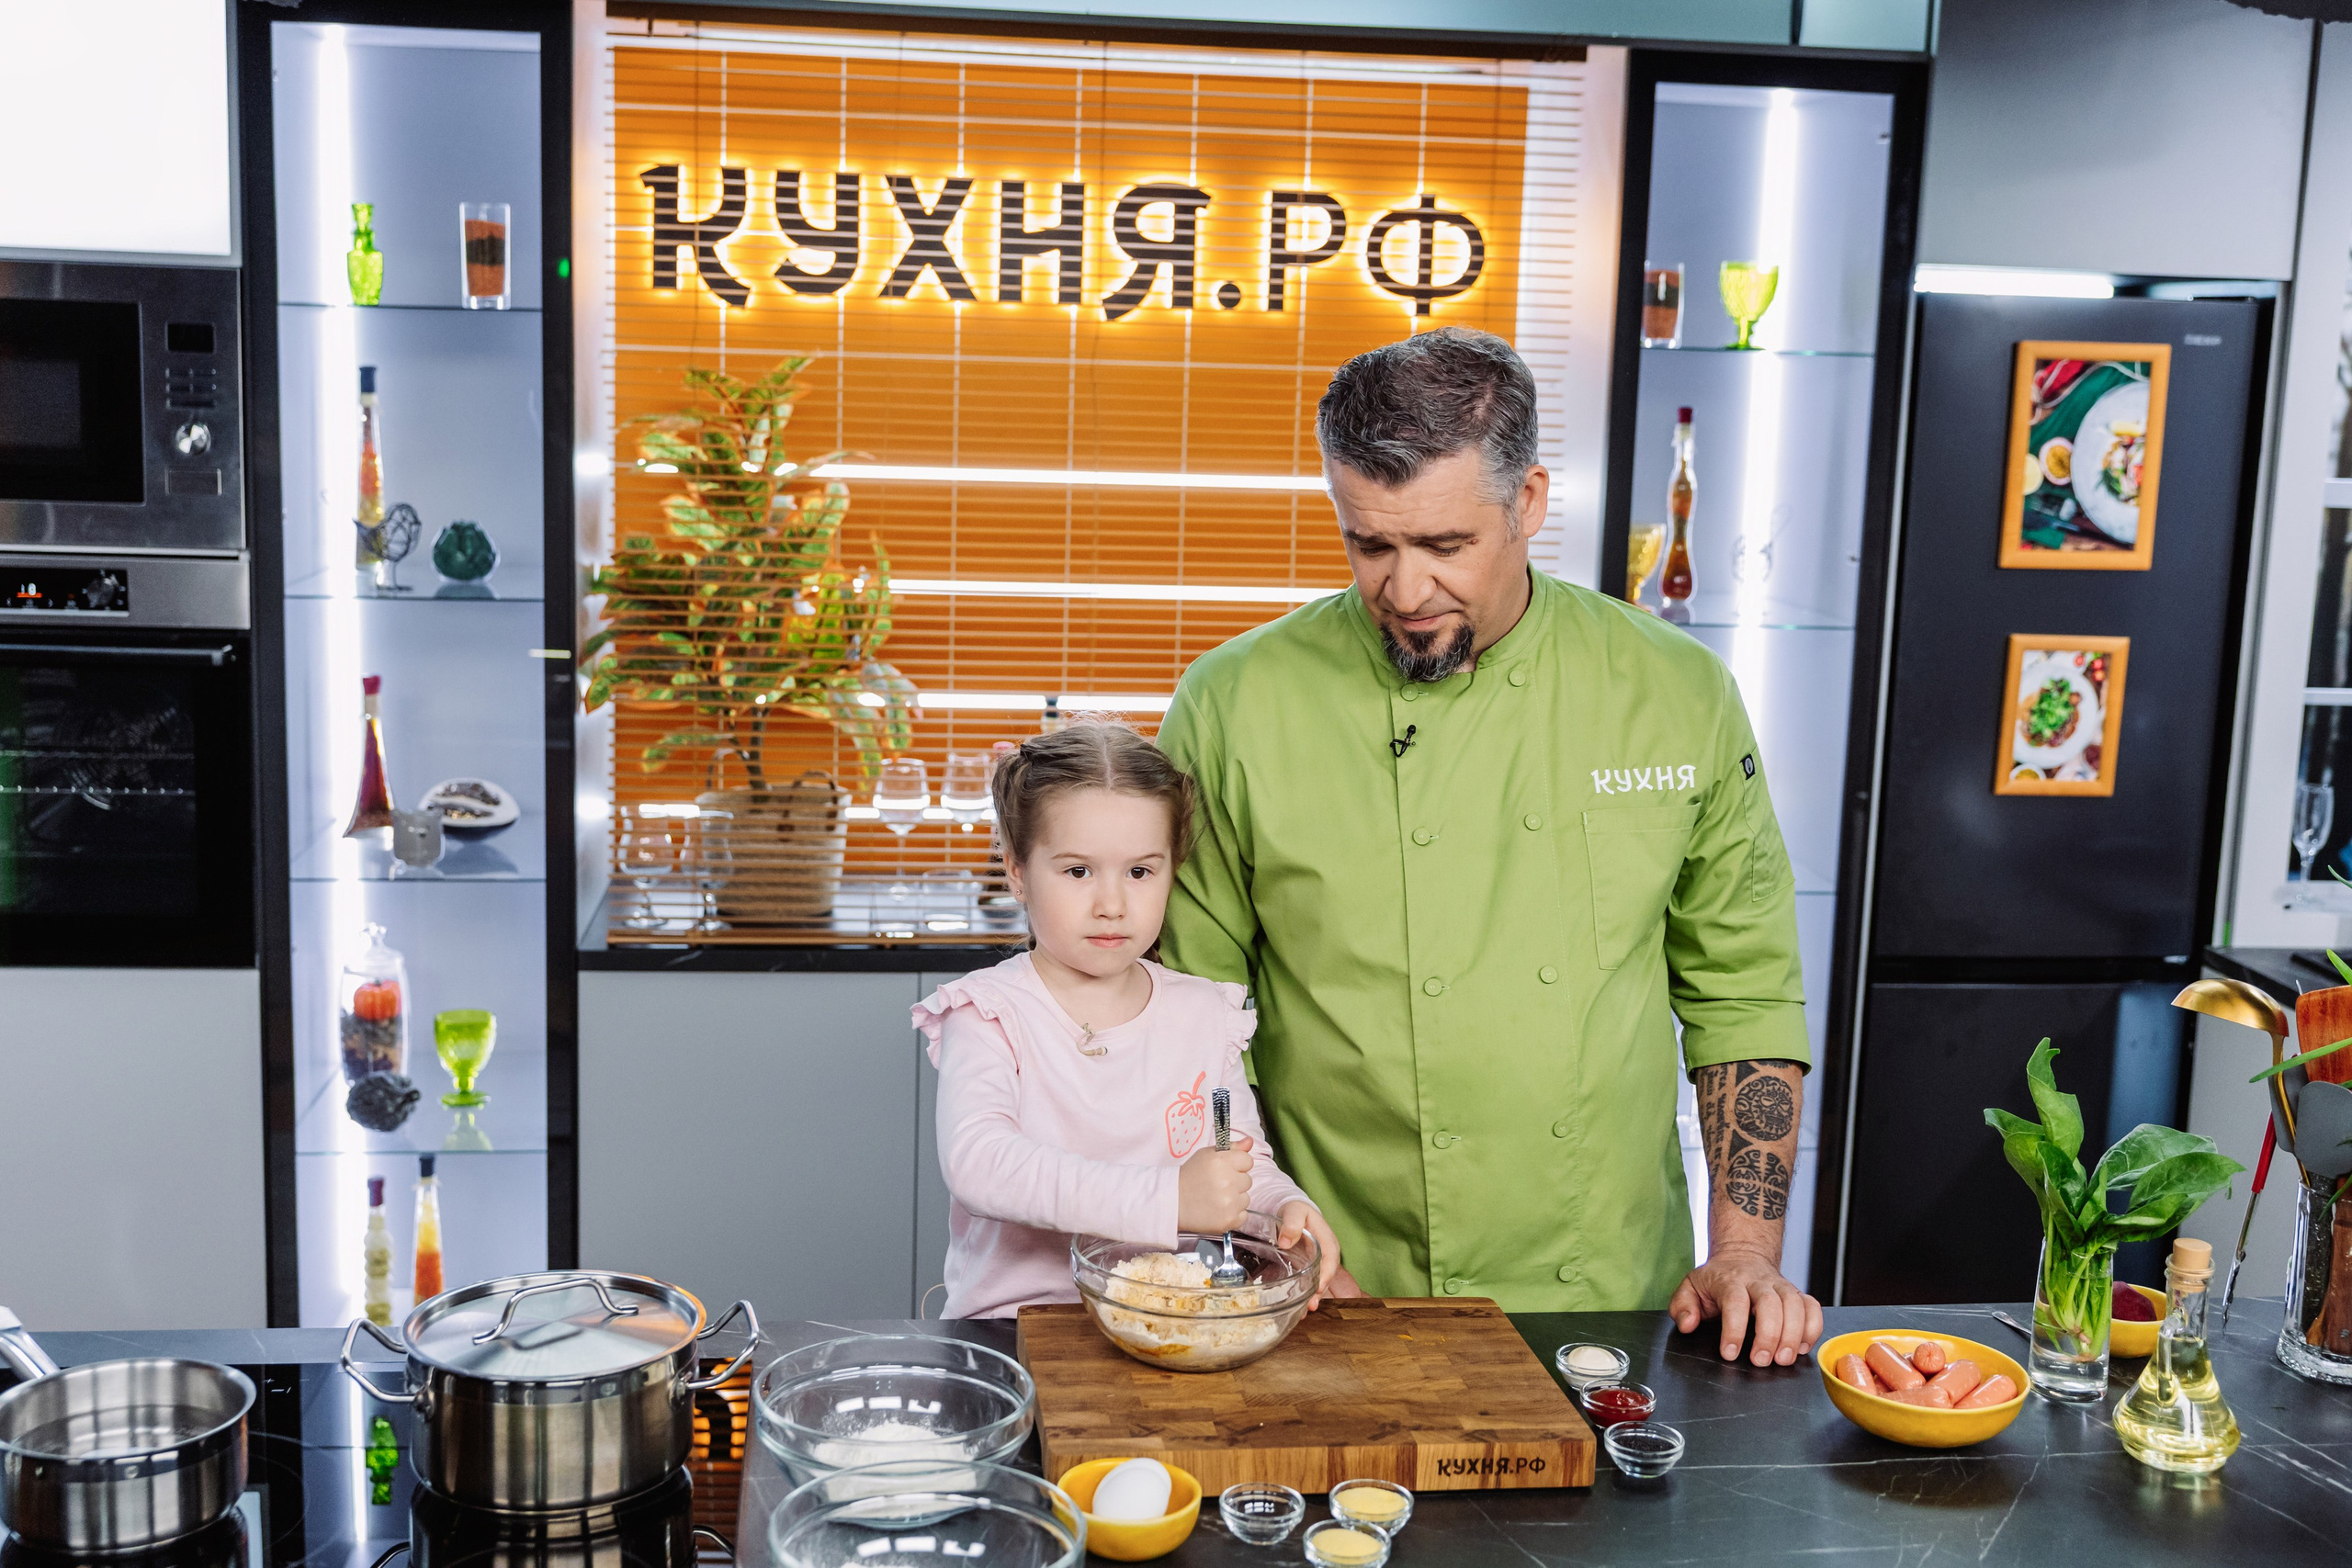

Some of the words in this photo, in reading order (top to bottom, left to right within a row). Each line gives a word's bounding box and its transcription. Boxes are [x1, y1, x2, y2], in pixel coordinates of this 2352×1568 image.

[640, 163, 1486, 321] КУХНЯ.РФ
[1590, 764, 1696, 795] КУХНЯ
[1437, 1457, 1546, 1477] КУХНЯ.РФ
